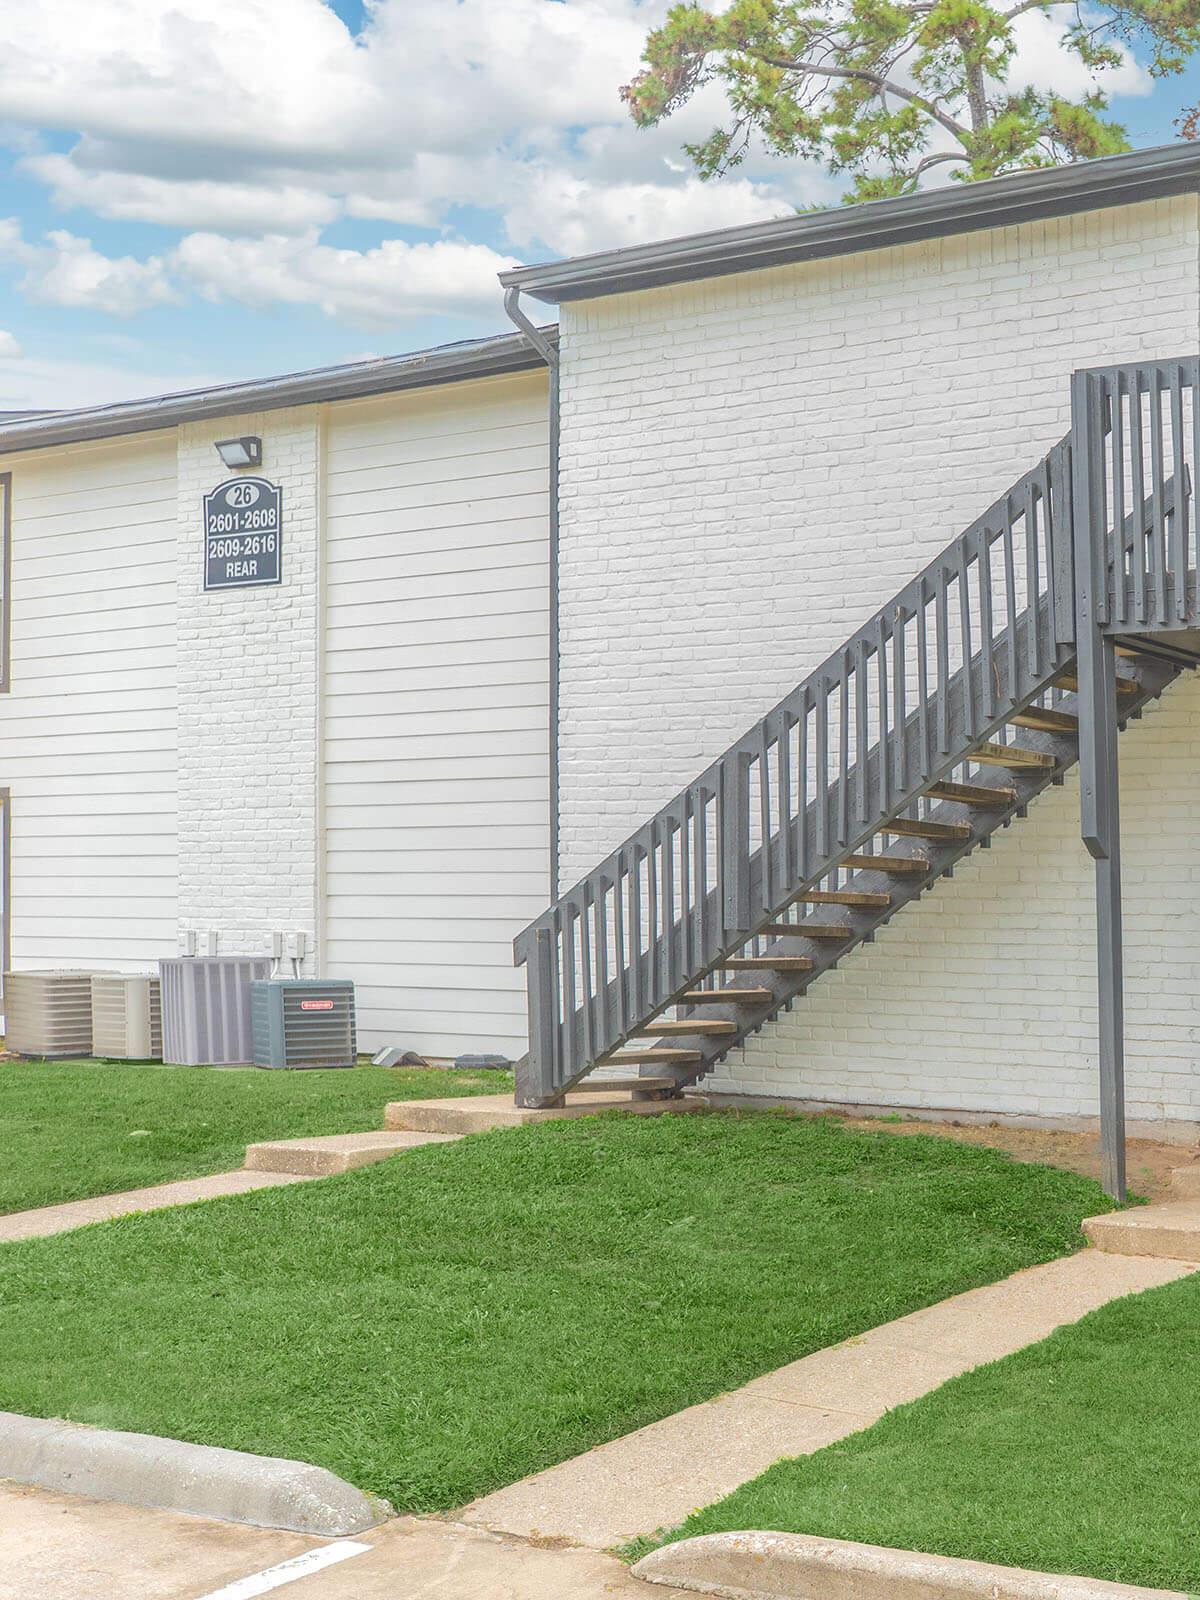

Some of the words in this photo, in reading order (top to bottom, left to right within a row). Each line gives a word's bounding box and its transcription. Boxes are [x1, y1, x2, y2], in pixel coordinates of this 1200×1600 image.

[234, 486, 252, 506] 26
[209, 508, 276, 533] 2601-2608
[209, 534, 276, 559] 2609-2616
[226, 560, 258, 578] REAR
